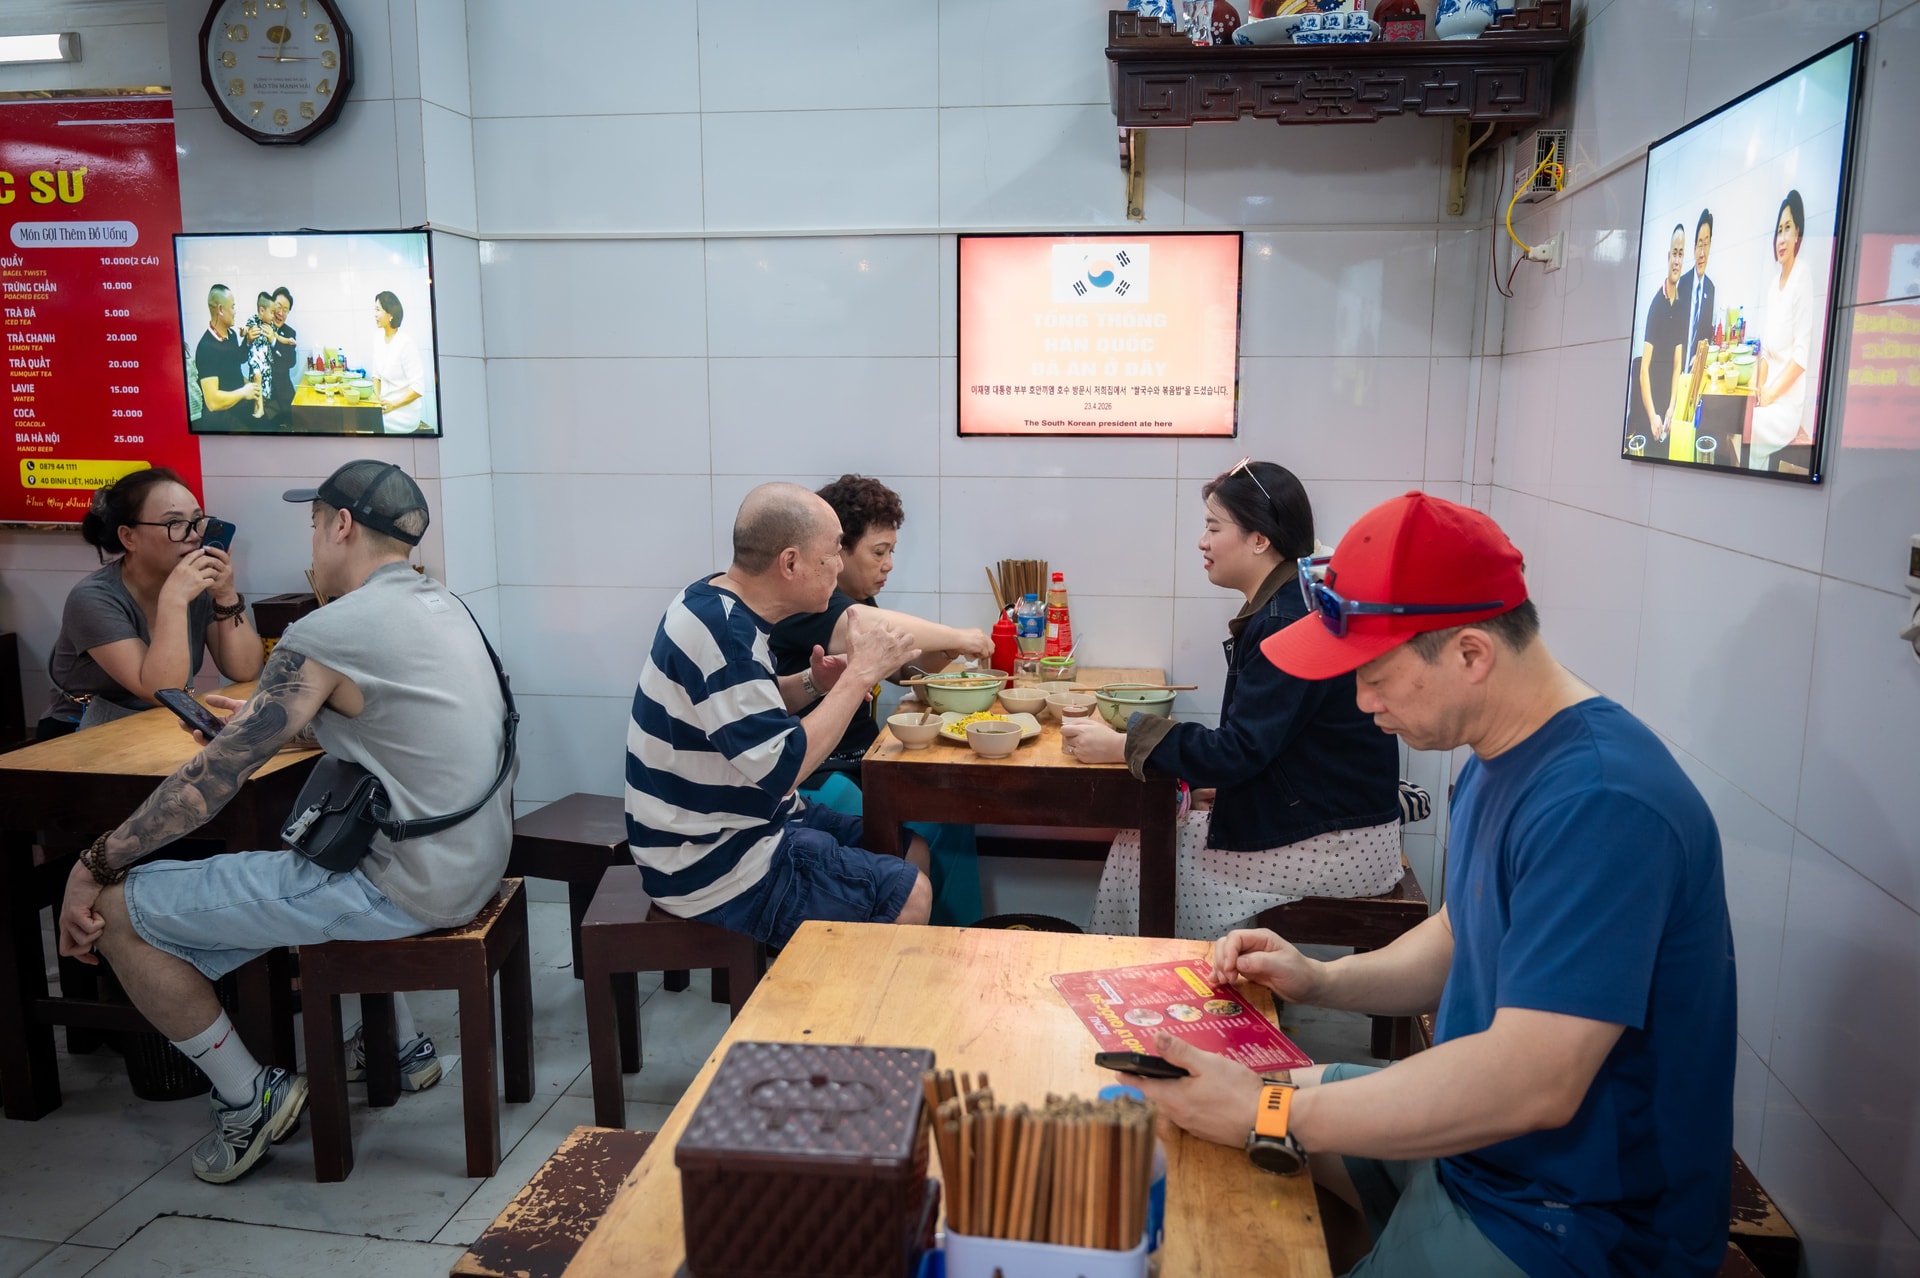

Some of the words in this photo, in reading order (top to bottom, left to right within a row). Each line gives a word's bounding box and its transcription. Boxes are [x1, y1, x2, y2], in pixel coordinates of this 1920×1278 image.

[226, 23, 248, 42] 10
[314, 23, 330, 42] 2
[222, 50, 237, 68] 9
[321, 50, 336, 69] 3
[230, 78, 245, 96] 8
[316, 78, 331, 96] 4
[250, 102, 264, 119] 7
[274, 108, 288, 126] 6
[300, 102, 315, 119] 5
[29, 165, 88, 205] SƯ
[20, 228, 40, 241] Món
[59, 227, 86, 240] Thêm
[102, 227, 128, 242] Uống
[141, 256, 159, 266] CÁI)
[102, 282, 132, 290] 10.000
[5, 307, 22, 317] TRÀ
[24, 306, 36, 317] ĐÁ
[105, 309, 130, 317] 5.000
[7, 331, 25, 343] TRÀ
[26, 334, 55, 343] CHANH
[106, 334, 137, 342] 20.000
[9, 357, 27, 368] TRÀ
[11, 383, 35, 393] LAVIE
[110, 386, 139, 394] 15.000
[971, 385, 990, 396] 이재명
[992, 385, 1012, 396] 대통령
[1014, 385, 1027, 396] 부부
[1057, 385, 1070, 396] 호수
[1072, 385, 1092, 396] 방문시
[14, 408, 35, 418] COCA
[1024, 419, 1039, 427] The
[1041, 419, 1065, 427] South
[1067, 419, 1096, 427] Korean
[1098, 419, 1137, 429] president
[1154, 419, 1173, 427] here
[16, 433, 30, 443] BIA
[31, 431, 43, 442] HÀ
[45, 432, 60, 444] NỘI
[114, 435, 144, 443] 25.000
[84, 476, 104, 485] HOÀN
[1087, 1016, 1112, 1036] MENU
